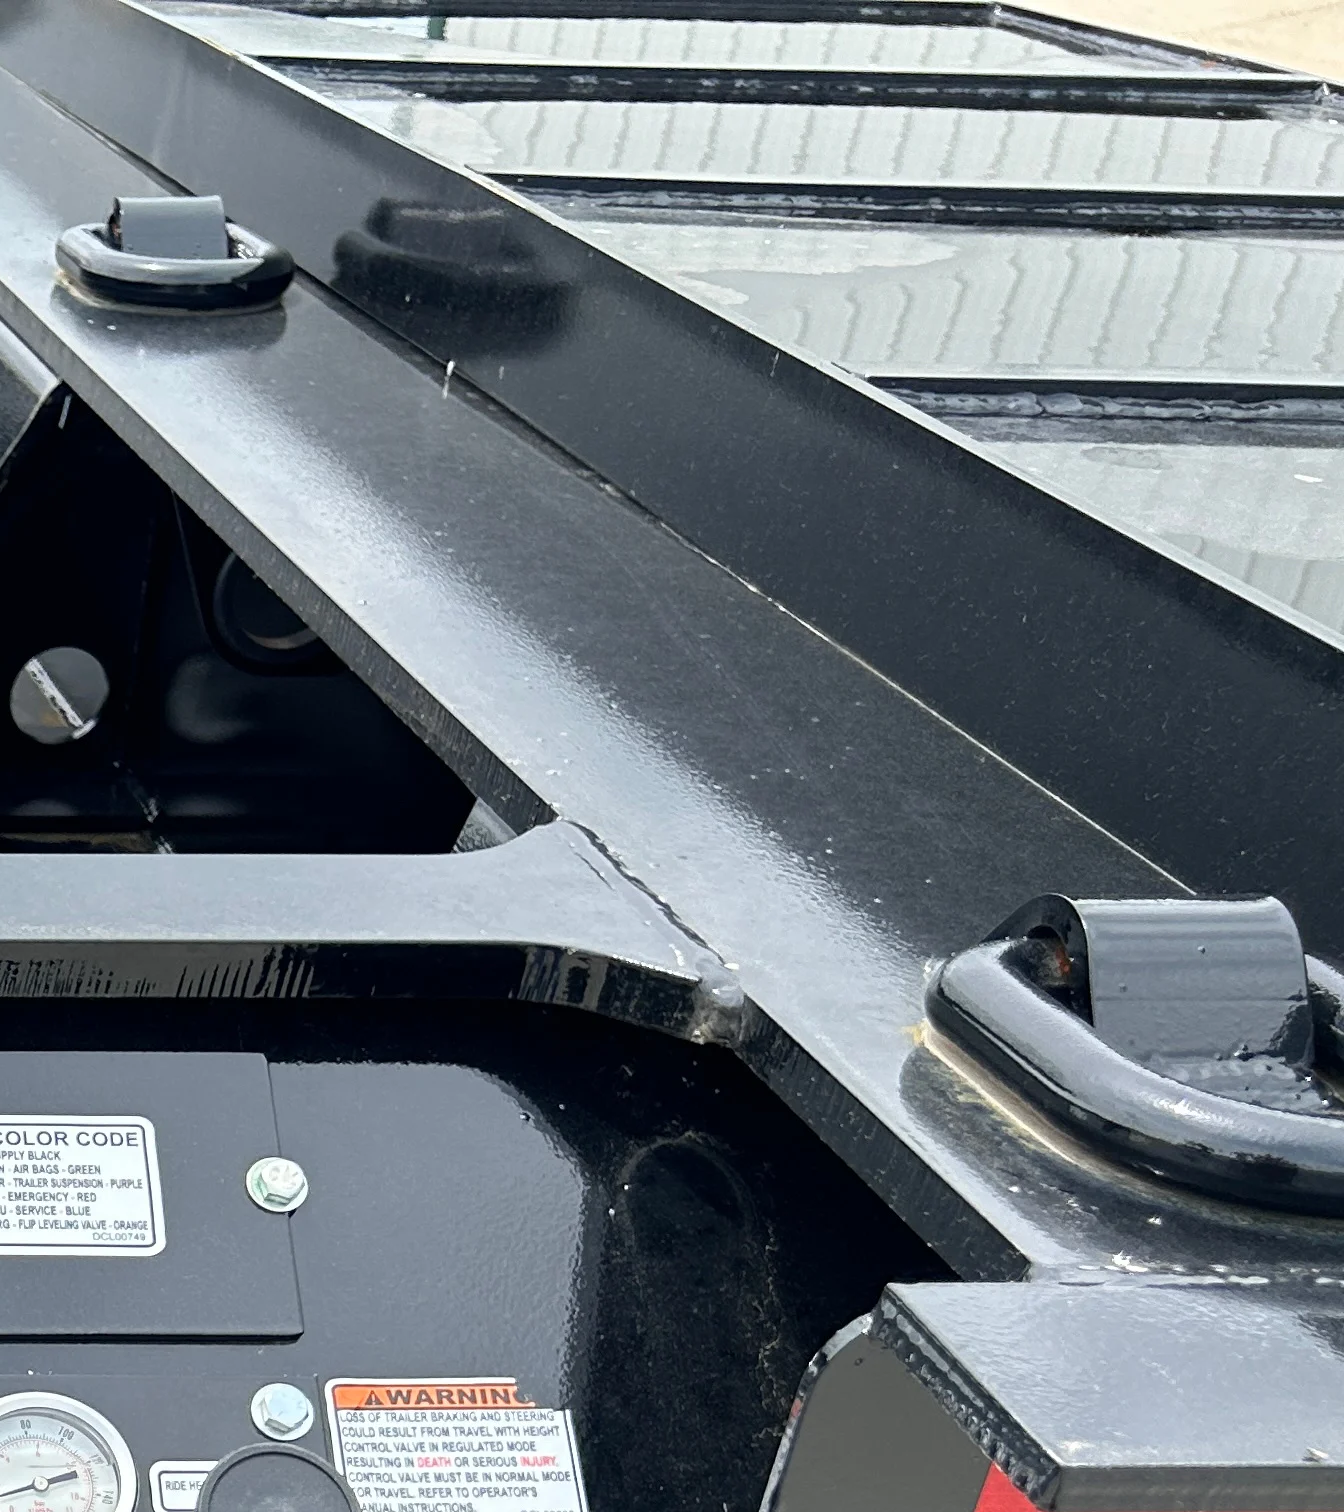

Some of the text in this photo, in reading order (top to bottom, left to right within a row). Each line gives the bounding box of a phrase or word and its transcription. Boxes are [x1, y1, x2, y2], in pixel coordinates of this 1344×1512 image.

[76, 1132, 139, 1147] CODE
[27, 1151, 60, 1161] BLACK
[13, 1164, 30, 1174] AIR
[32, 1164, 59, 1174] BAGS
[68, 1164, 101, 1175] GREEN
[13, 1178, 48, 1188] TRAILER
[51, 1178, 103, 1188] SUSPENSION
[110, 1179, 143, 1189] PURPLE
[8, 1192, 68, 1202] EMERGENCY
[77, 1192, 96, 1202] RED
[15, 1206, 56, 1215] SERVICE
[65, 1206, 91, 1216] BLUE
[18, 1220, 36, 1229] FLIP
[38, 1220, 79, 1229] LEVELING
[81, 1220, 107, 1229] VALVE
[113, 1220, 148, 1230] ORANGE
[340, 1412, 555, 1422] LOSS OF TRAILER BRAKING AND STEERING
[20, 1419, 32, 1429] 80
[58, 1426, 75, 1440] 100
[342, 1426, 560, 1437] COULD RESULT FROM TRAVEL WITH HEIGHT
[344, 1441, 536, 1452] CONTROL VALVE IN REGULATED MODE
[346, 1457, 401, 1467] RESULTING
[404, 1457, 414, 1467] IN
[417, 1457, 451, 1467] DEATH
[454, 1457, 469, 1467] OR
[473, 1456, 517, 1467] SERIOUS
[349, 1471, 571, 1483] CONTROL VALVE MUST BE IN NORMAL MODE
[165, 1481, 187, 1490] RIDE
[102, 1490, 114, 1505] 140
[419, 1487, 453, 1498] REFER
[456, 1487, 469, 1498] TO
[472, 1486, 537, 1497] OPERATOR'S
[398, 1502, 476, 1512] INSTRUCTIONS.
